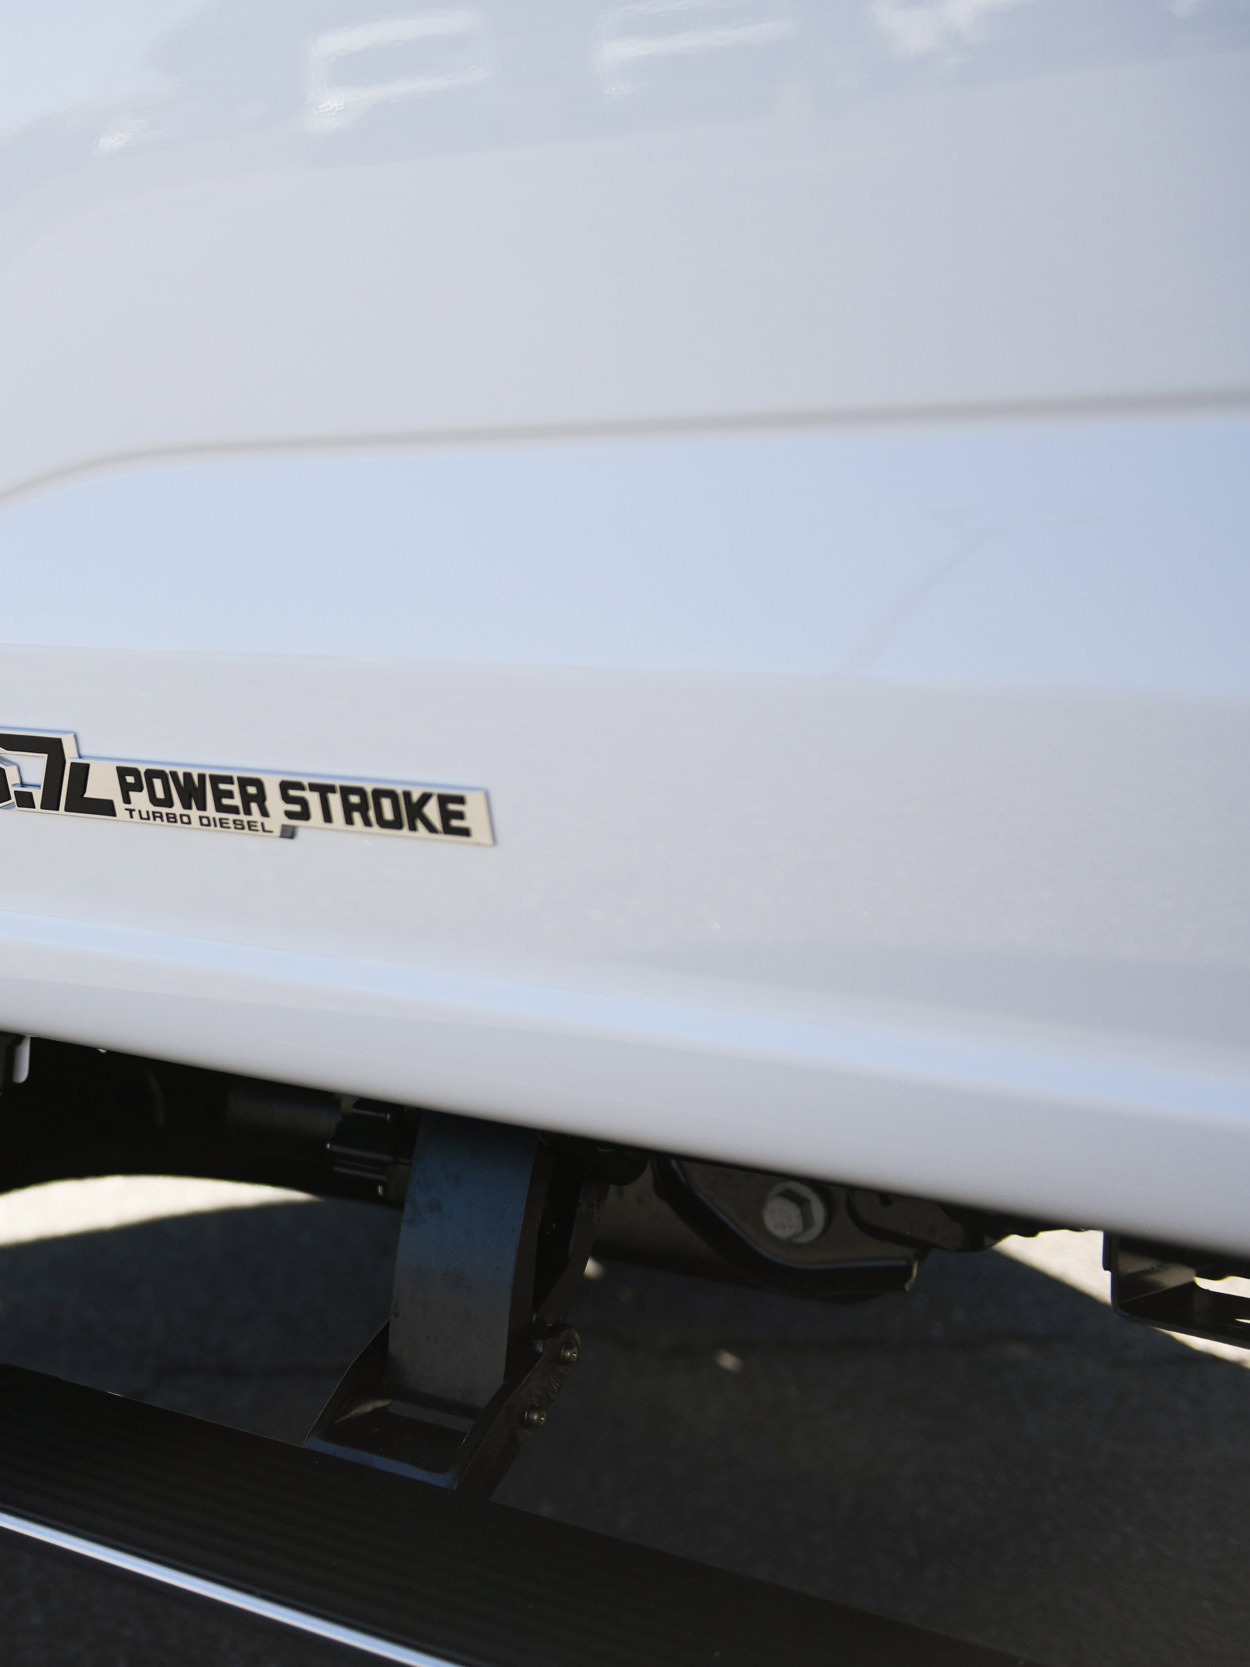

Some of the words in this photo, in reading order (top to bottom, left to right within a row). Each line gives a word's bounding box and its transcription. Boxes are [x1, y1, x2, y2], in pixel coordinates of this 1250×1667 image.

[115, 765, 271, 818] POWER
[278, 780, 472, 837] STROKE
[124, 807, 192, 826] TURBO
[198, 815, 274, 834] DIESEL
